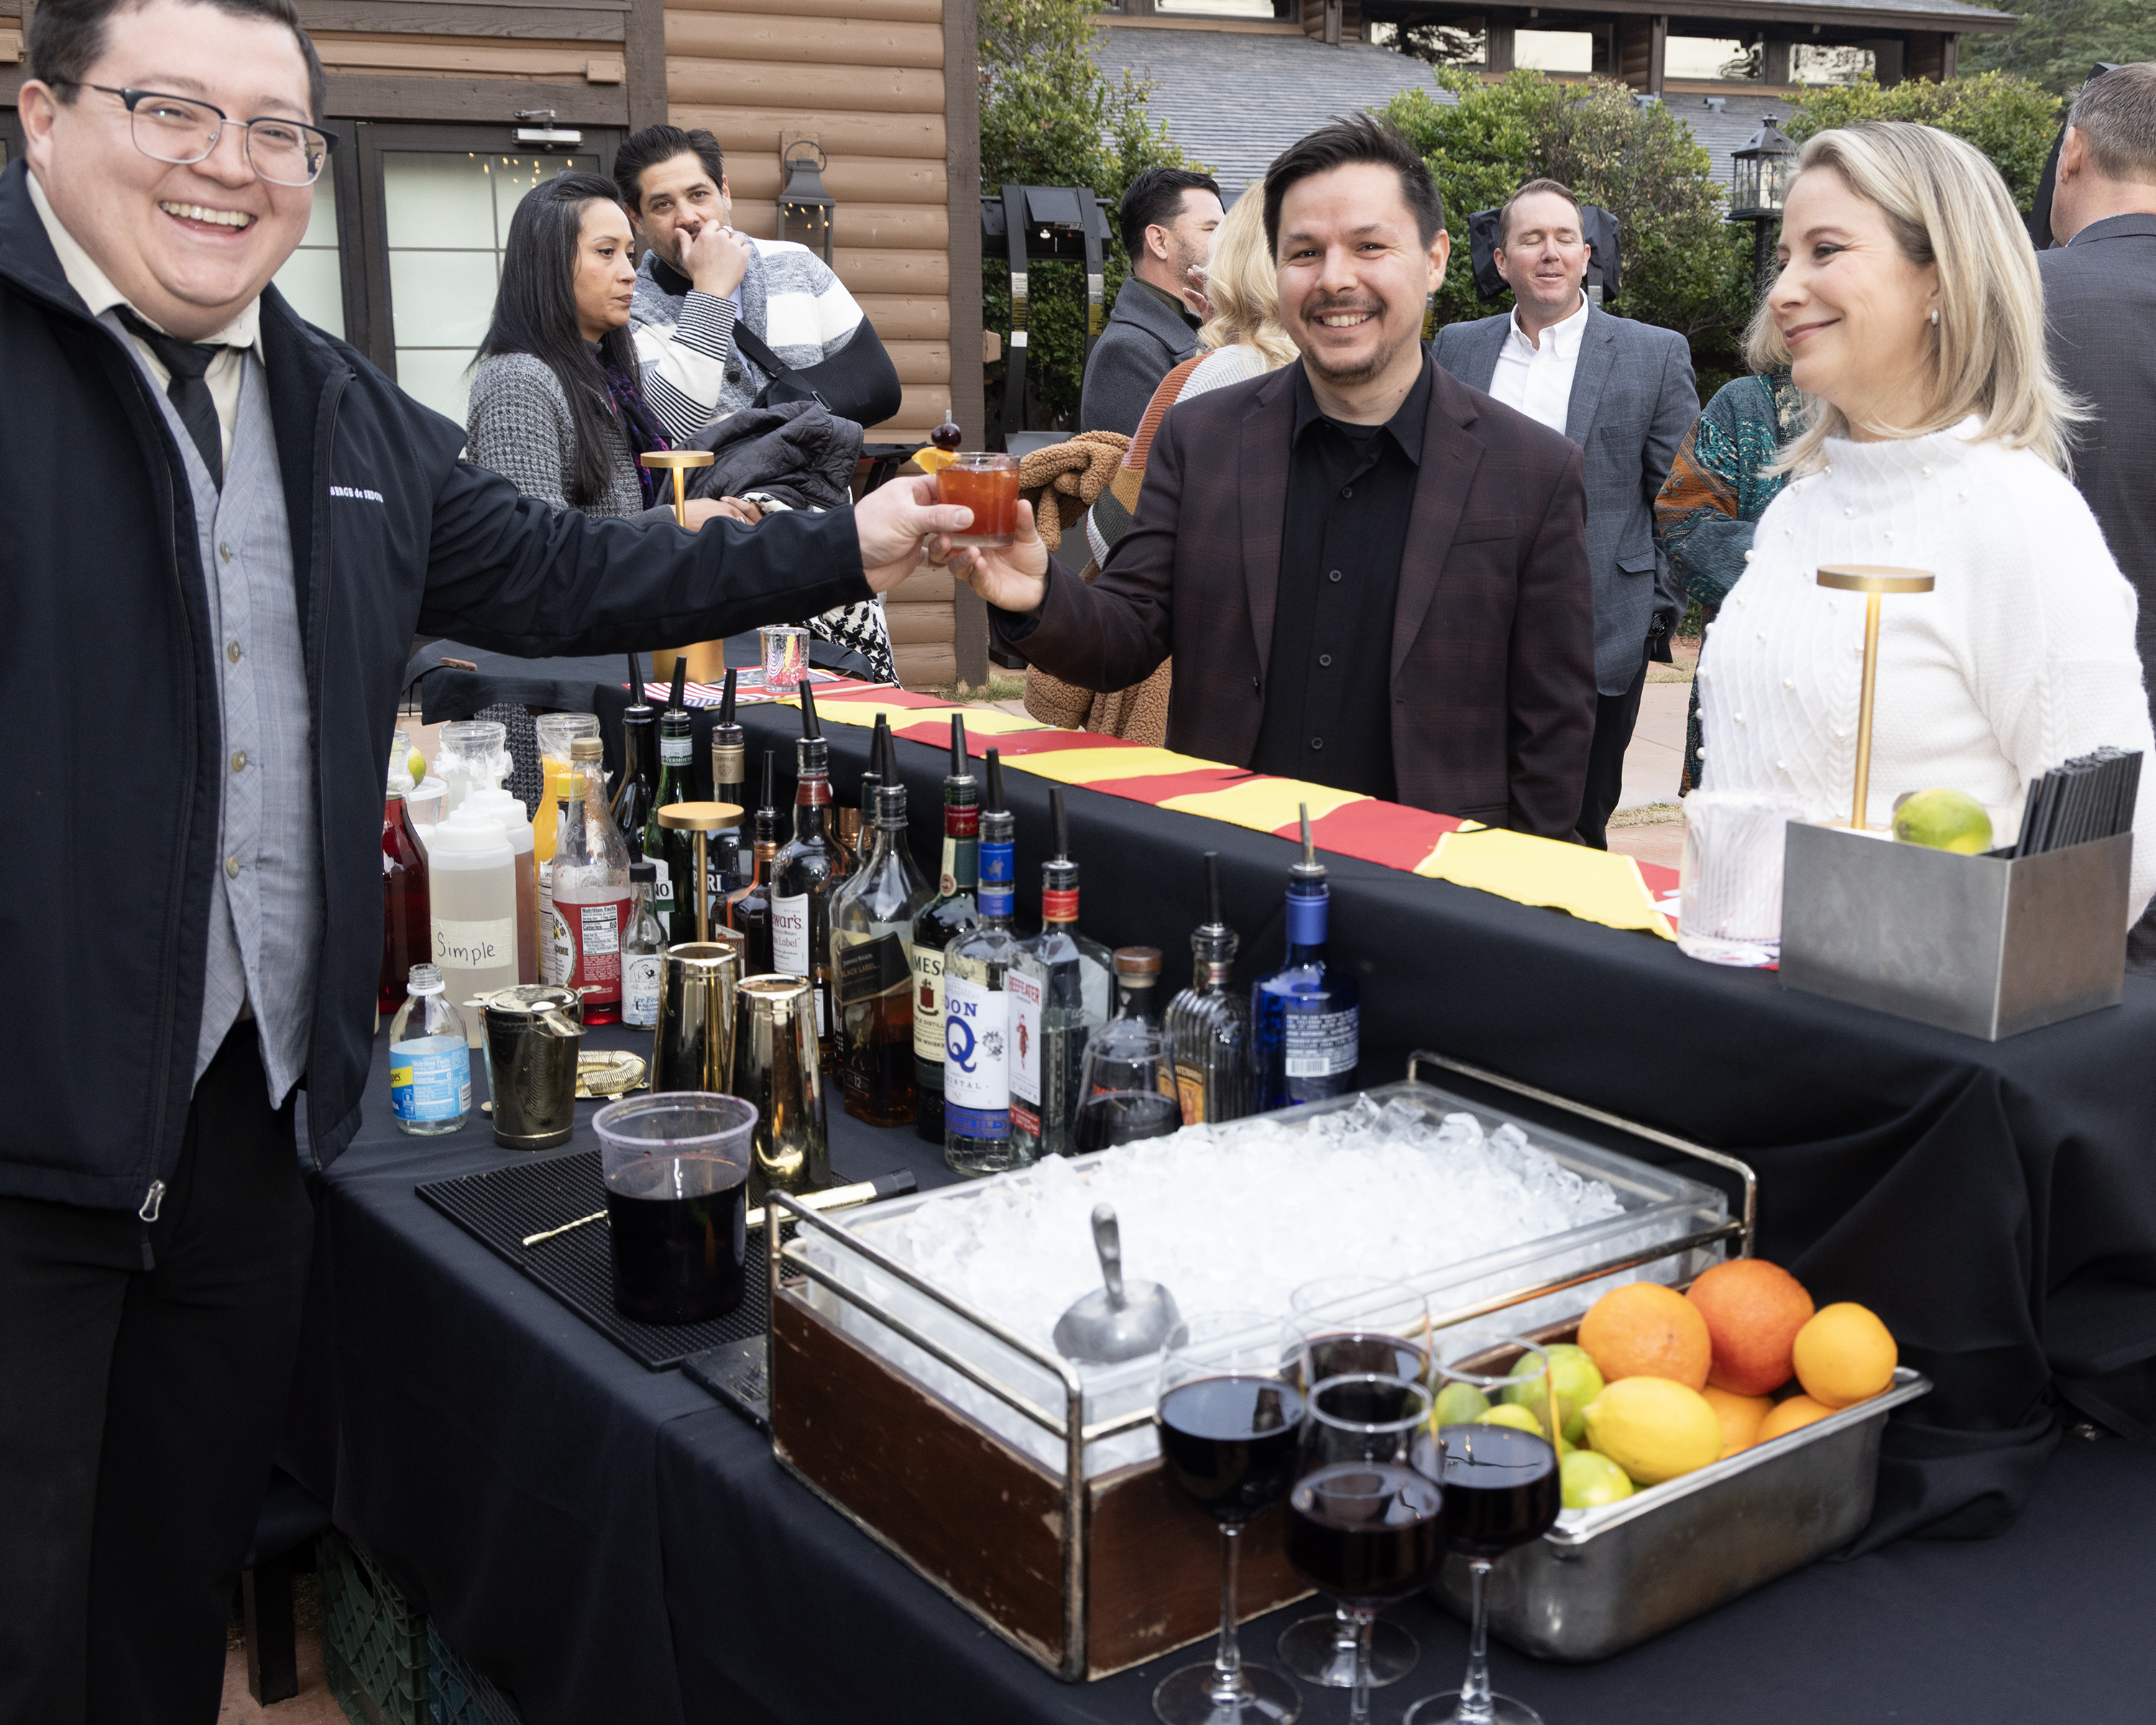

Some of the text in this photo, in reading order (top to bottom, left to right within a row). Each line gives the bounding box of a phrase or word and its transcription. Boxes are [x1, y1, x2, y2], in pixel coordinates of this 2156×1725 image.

[354, 487, 363, 499] de
[437, 931, 496, 966] Simple
[914, 954, 945, 978] MES
[1009, 975, 1040, 1006] BEEFEATER
[946, 1015, 979, 1073] Q
[854, 1075, 862, 1089] 12
